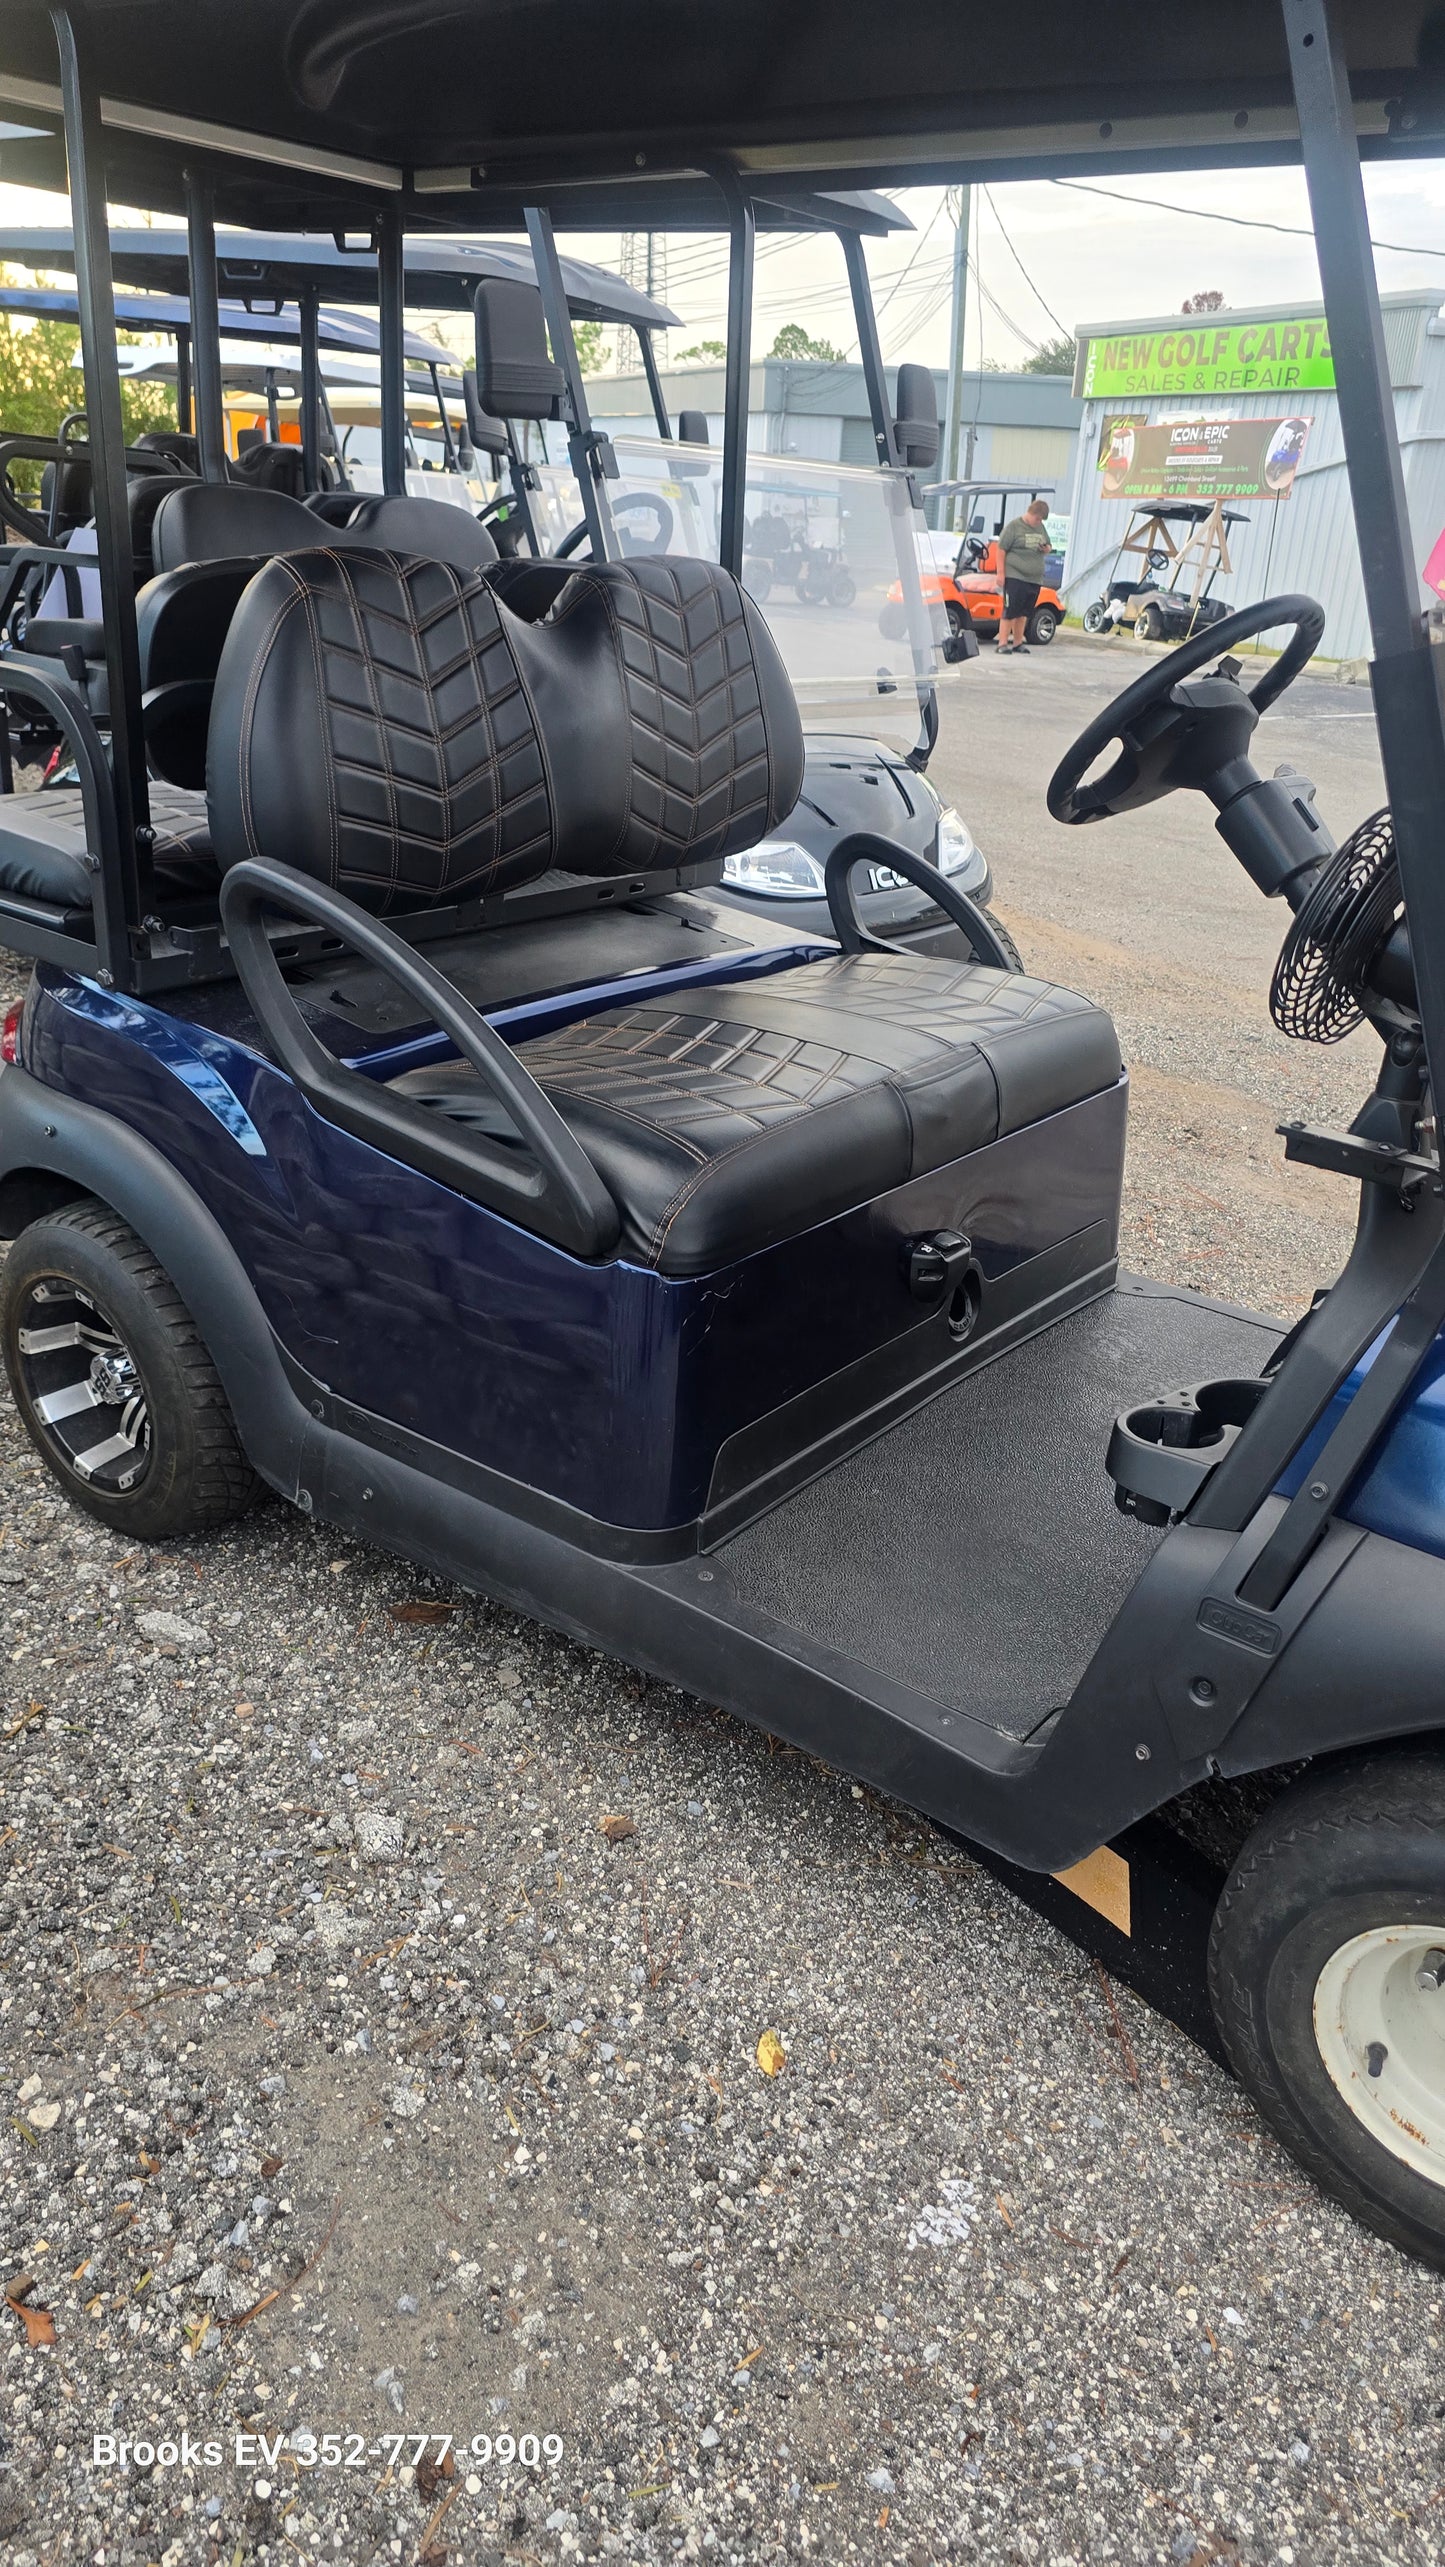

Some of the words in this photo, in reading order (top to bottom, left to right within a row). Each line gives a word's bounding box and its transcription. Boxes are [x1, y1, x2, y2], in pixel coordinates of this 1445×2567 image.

[1102, 338, 1156, 372] NEW
[1157, 330, 1230, 369] GOLF
[1085, 342, 1097, 396] ICON
[1124, 372, 1187, 393] SALES
[1192, 372, 1207, 390] &
[1213, 365, 1301, 389] REPAIR
[1170, 427, 1200, 442] ICON
[1203, 425, 1230, 440] EPIC
[1196, 484, 1214, 495] 352
[1215, 484, 1234, 495] 777
[1235, 484, 1259, 495] 9909
